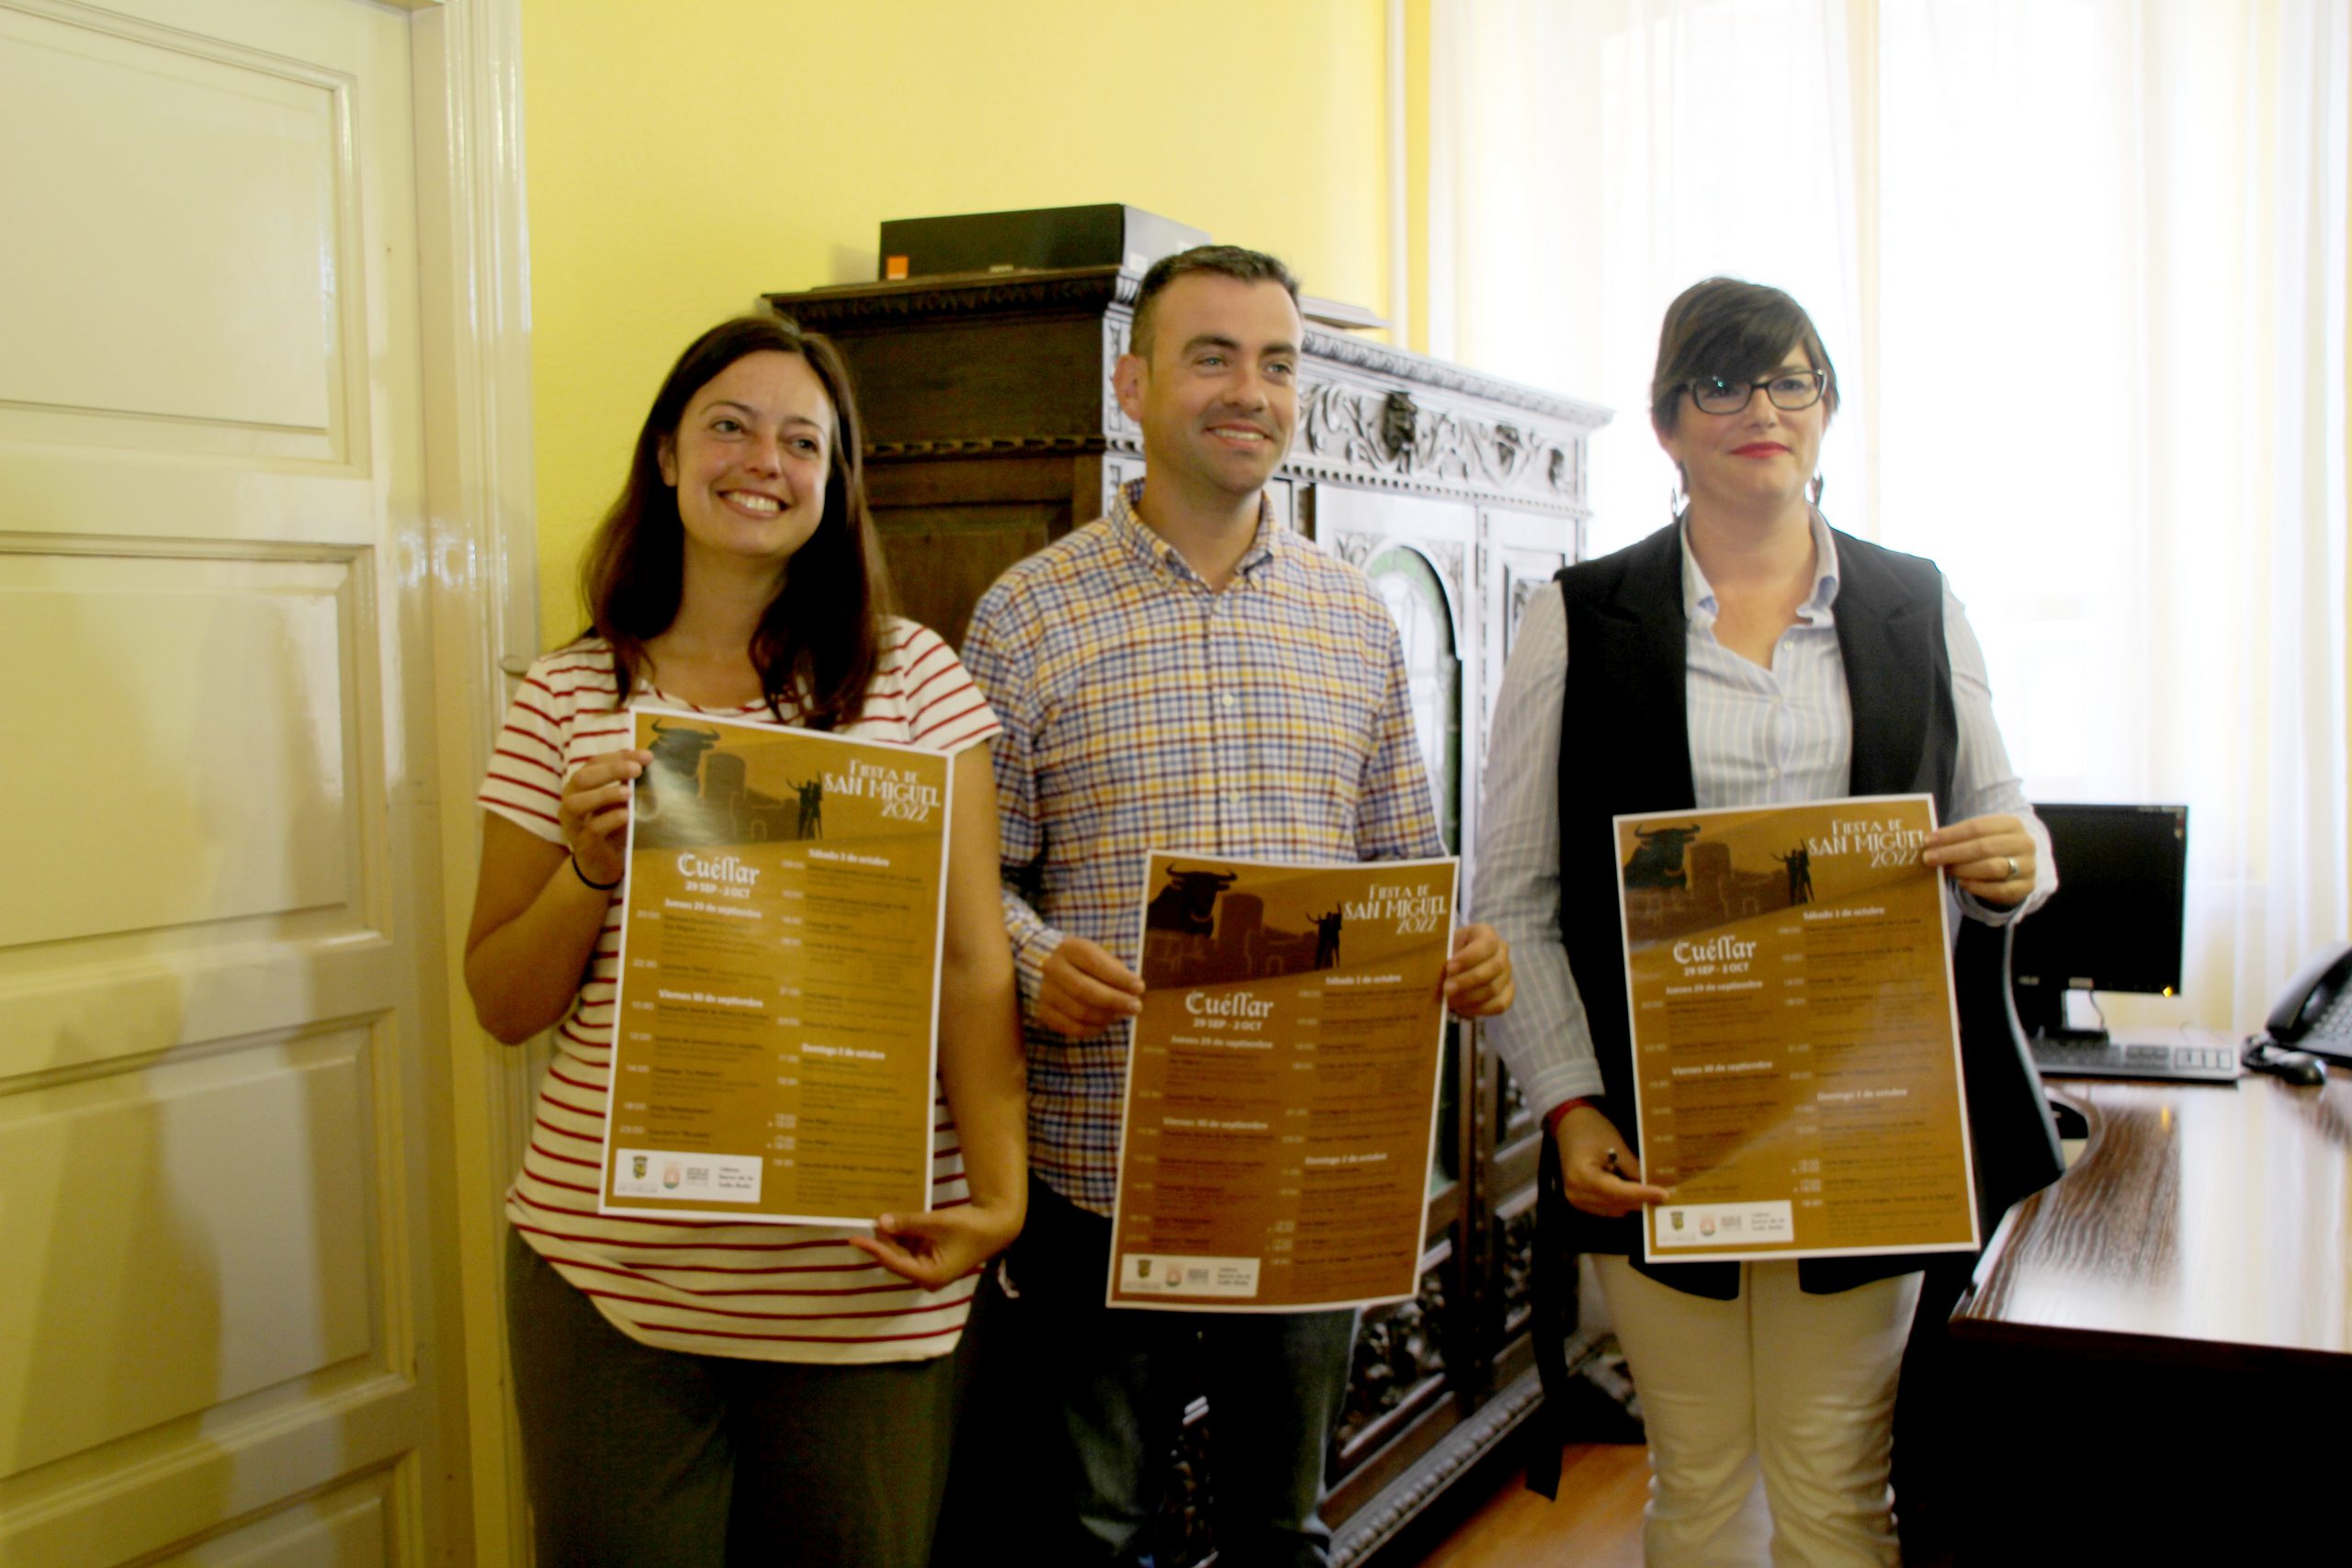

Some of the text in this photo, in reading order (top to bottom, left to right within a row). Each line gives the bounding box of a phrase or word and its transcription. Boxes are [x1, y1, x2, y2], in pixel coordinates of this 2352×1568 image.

[824, 772, 941, 807] SAN MIGUEL
[881, 801, 928, 823] 2022
[1808, 829, 1925, 855] SAN MIGUEL
[677, 852, 761, 885] Cuéllar
[1871, 849, 1918, 868] 2022
[1343, 896, 1447, 920] SAN MIGUEL
[1396, 916, 1438, 935] 2022
[1673, 935, 1757, 964] Cuéllar
[1185, 991, 1274, 1018] Cuéllar
